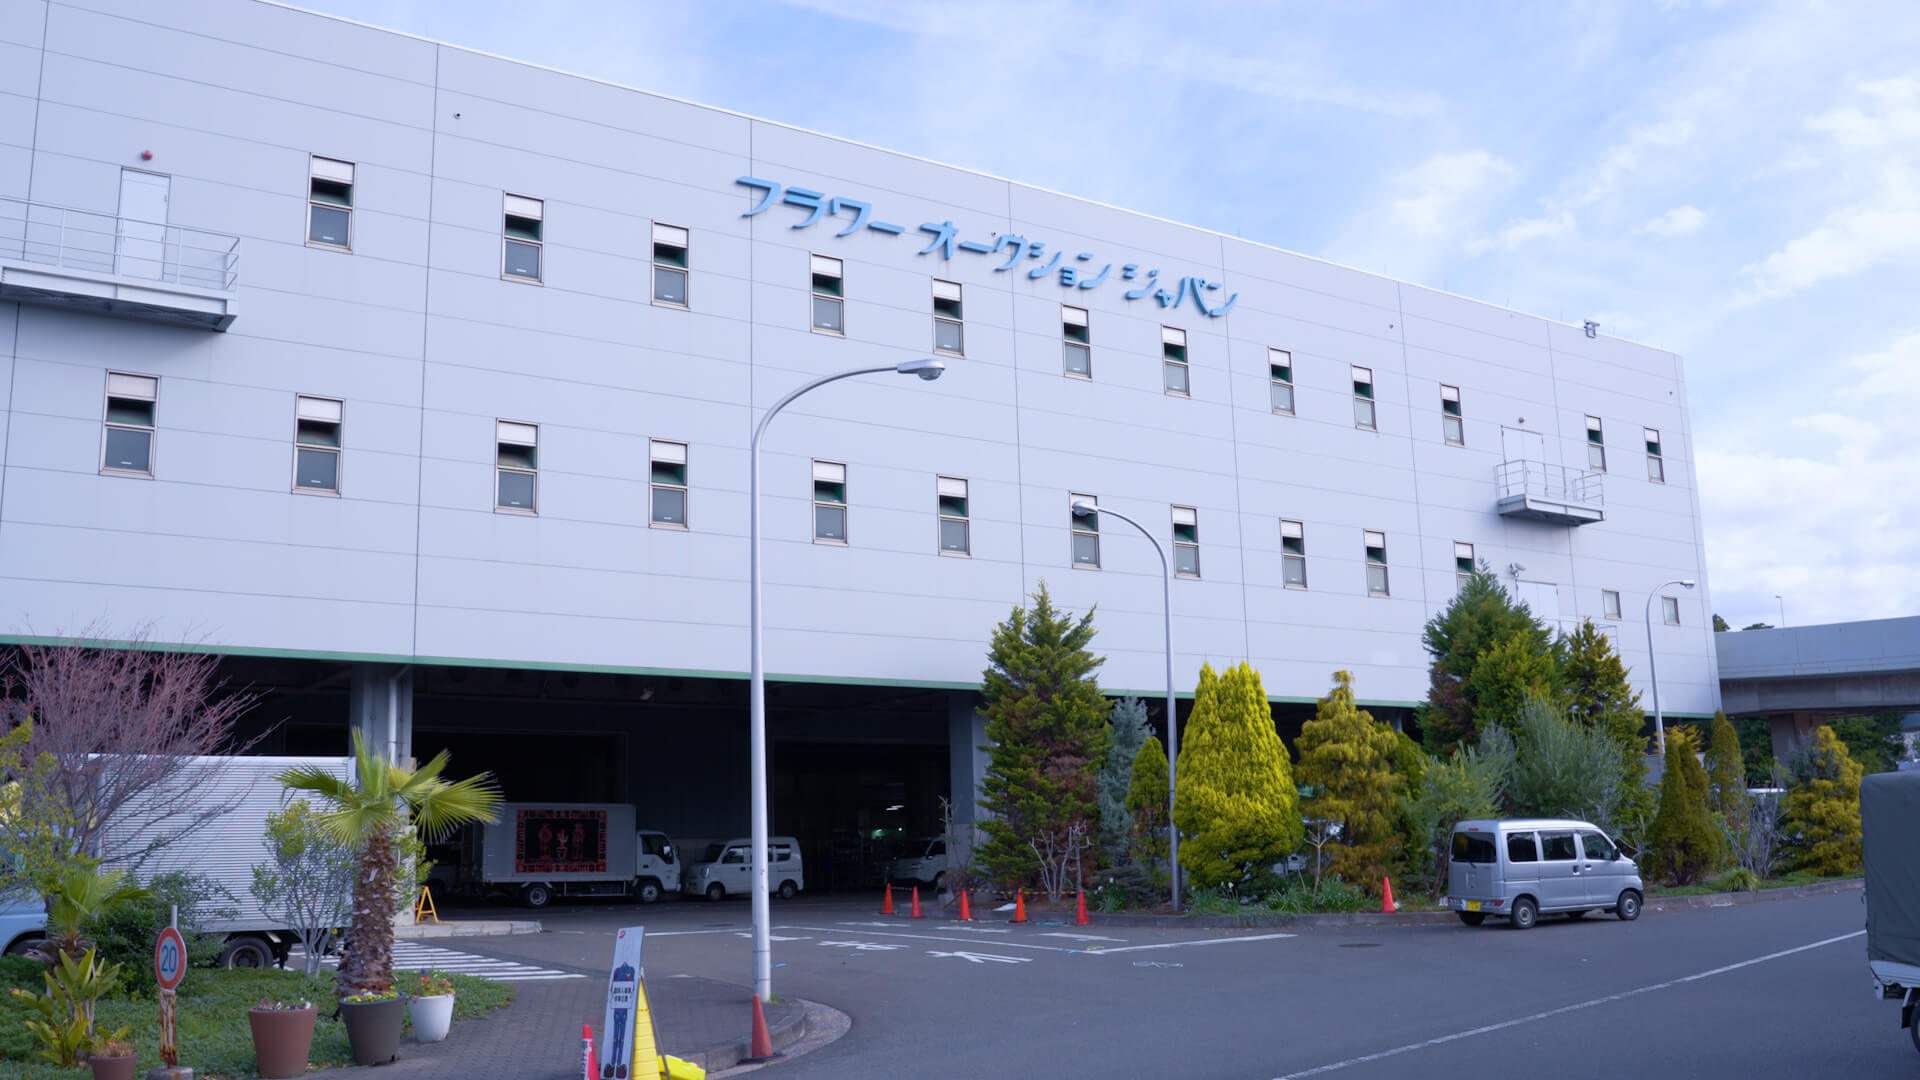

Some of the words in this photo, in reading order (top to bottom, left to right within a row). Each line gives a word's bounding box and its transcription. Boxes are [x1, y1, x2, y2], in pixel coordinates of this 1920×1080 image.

[735, 175, 905, 238] フラワー
[918, 220, 1112, 290] オークション
[1122, 263, 1239, 318] ジャパン
[161, 945, 177, 973] 20
